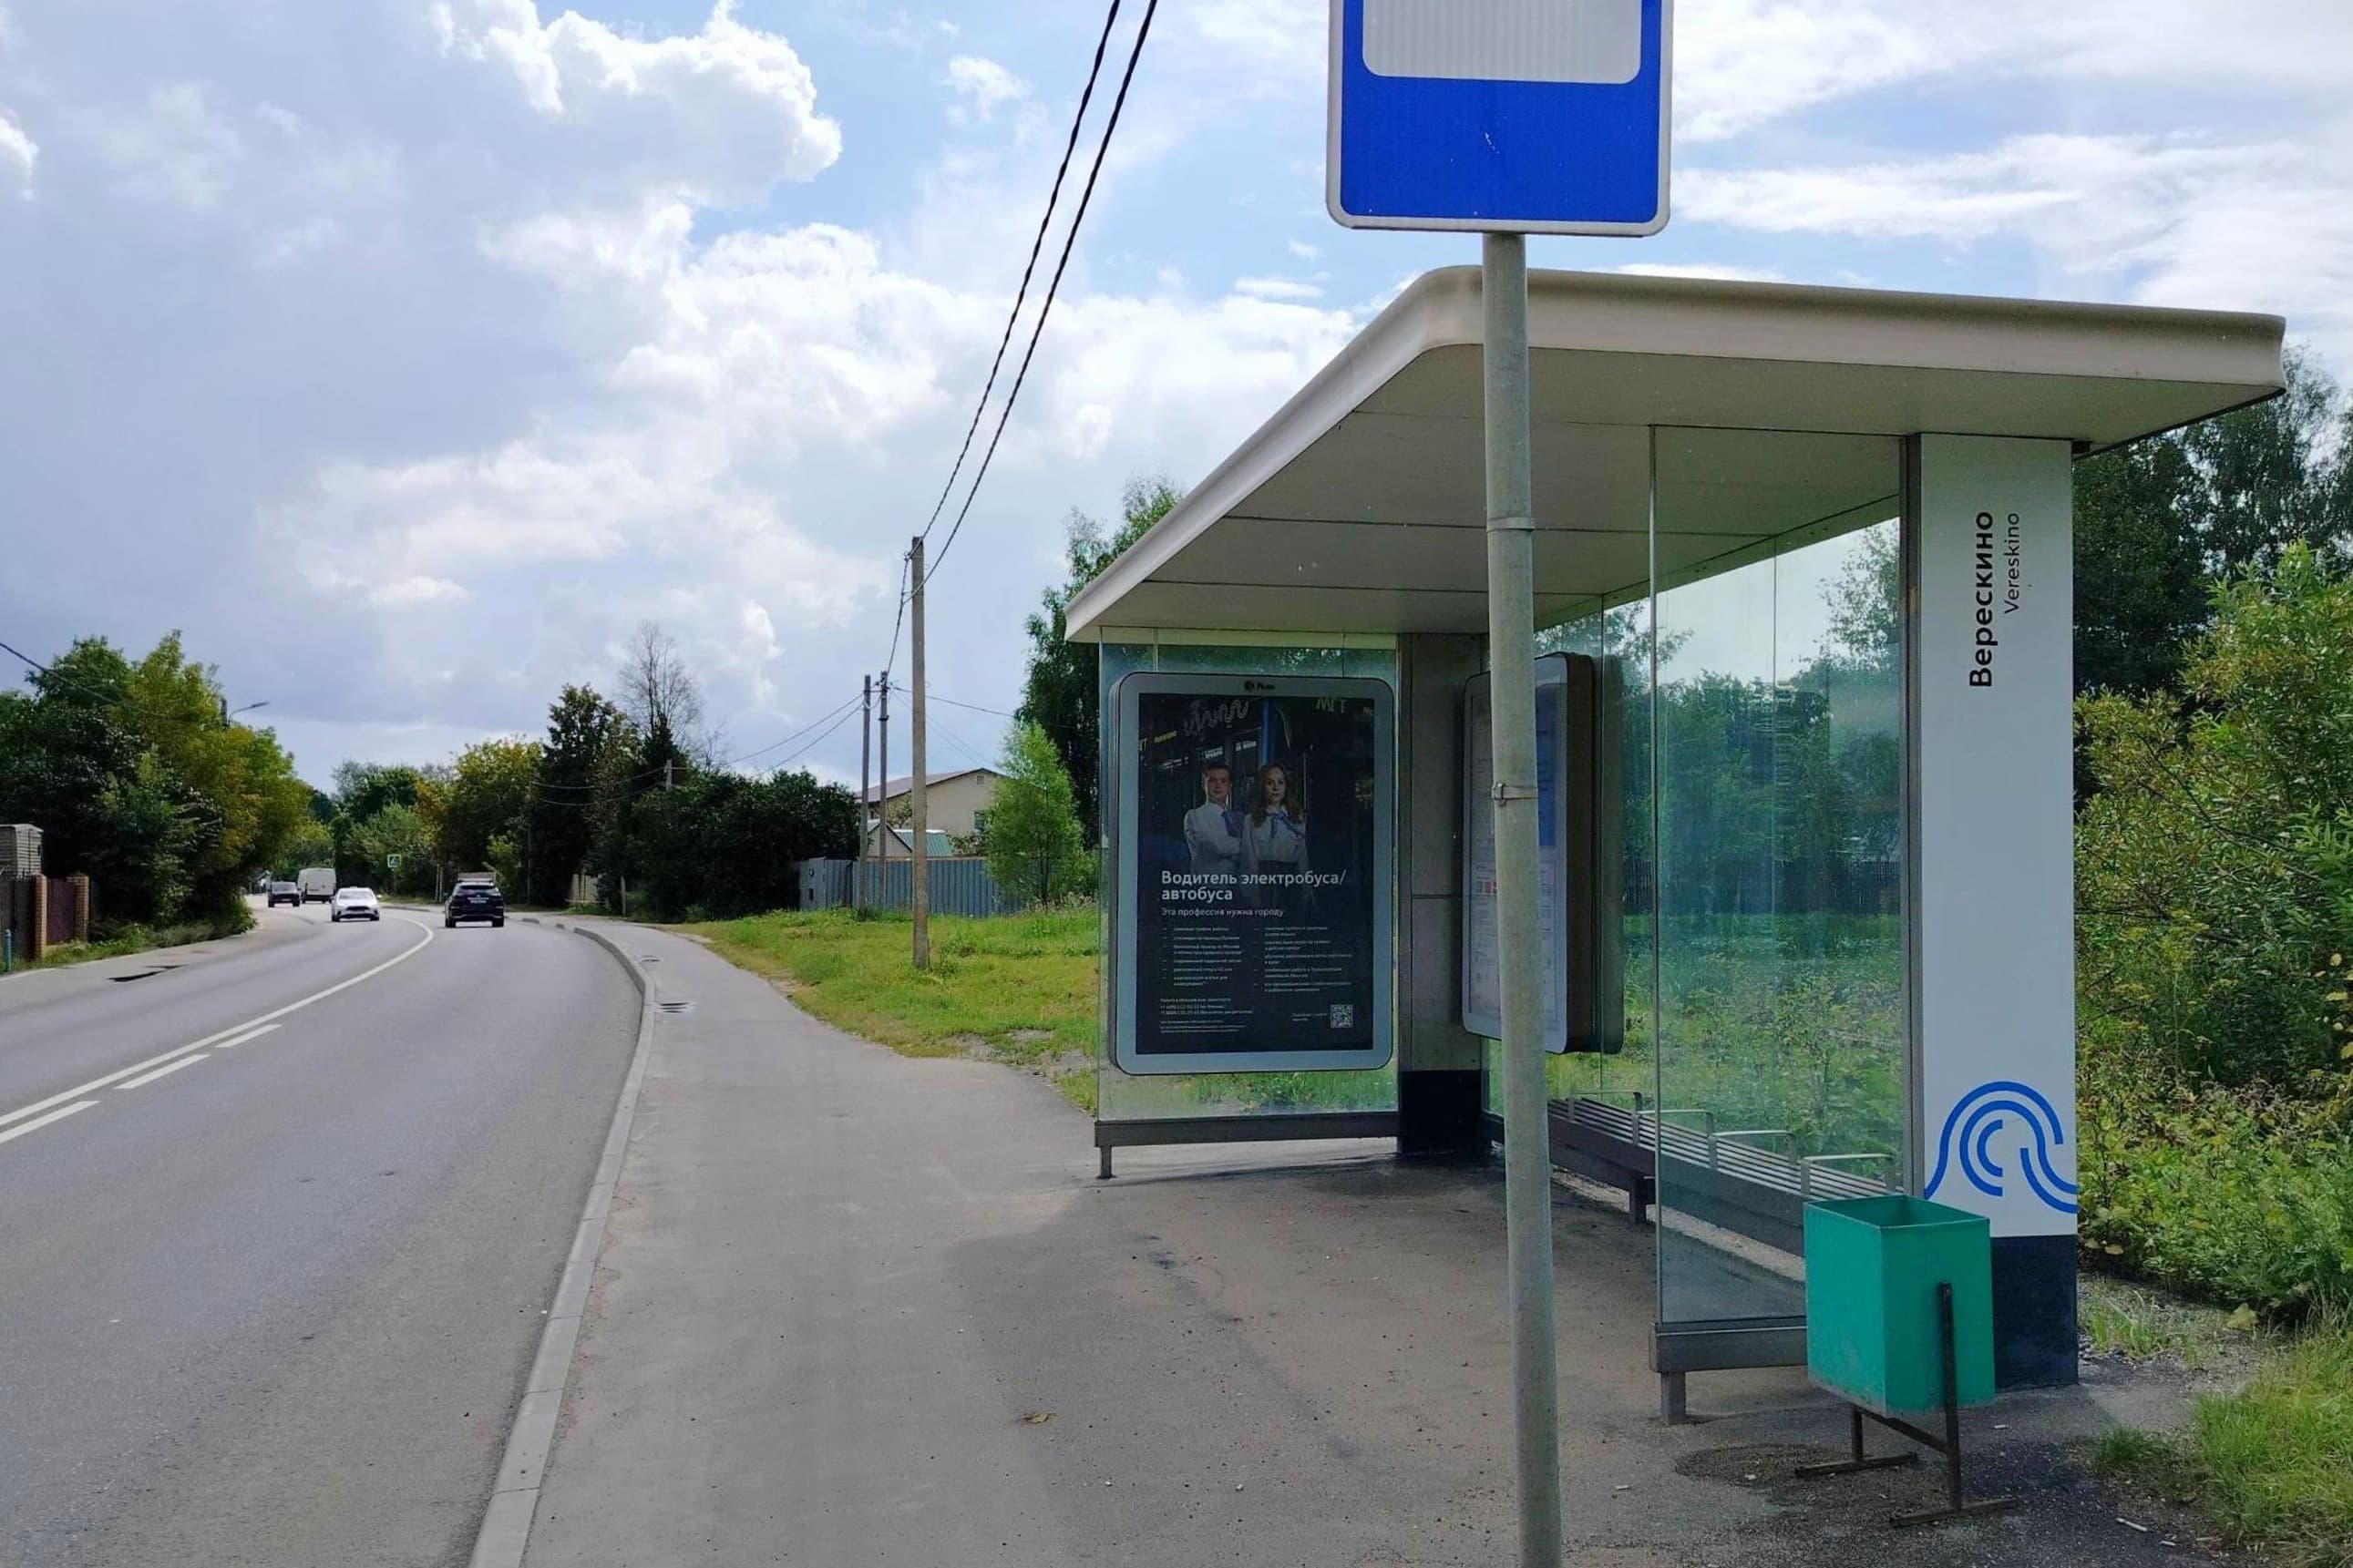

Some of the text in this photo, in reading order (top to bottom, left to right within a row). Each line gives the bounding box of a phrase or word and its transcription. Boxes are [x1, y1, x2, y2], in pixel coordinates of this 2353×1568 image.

[2003, 513, 2019, 614] Vereskino
[1969, 512, 1998, 686] Верескино
[1161, 869, 1347, 887] Водитель электробуса/
[1161, 886, 1233, 903] автобуса
[1161, 907, 1284, 917] Эта профессия нужна городу
